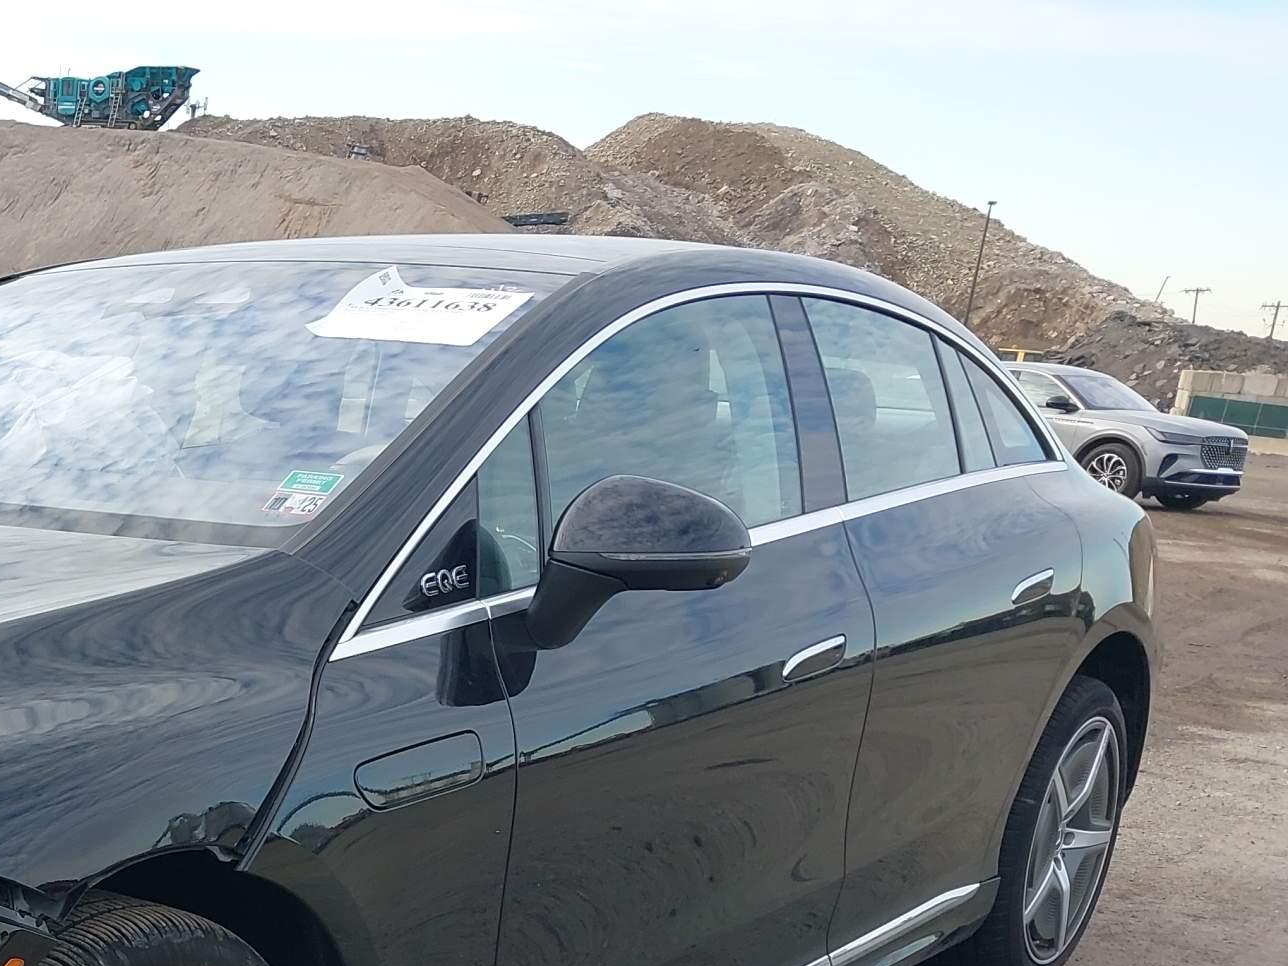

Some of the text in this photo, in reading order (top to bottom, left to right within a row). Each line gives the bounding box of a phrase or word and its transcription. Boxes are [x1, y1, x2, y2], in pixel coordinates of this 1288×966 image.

[364, 296, 497, 313] 43611638
[300, 496, 324, 513] 25
[421, 565, 470, 597] EQE
